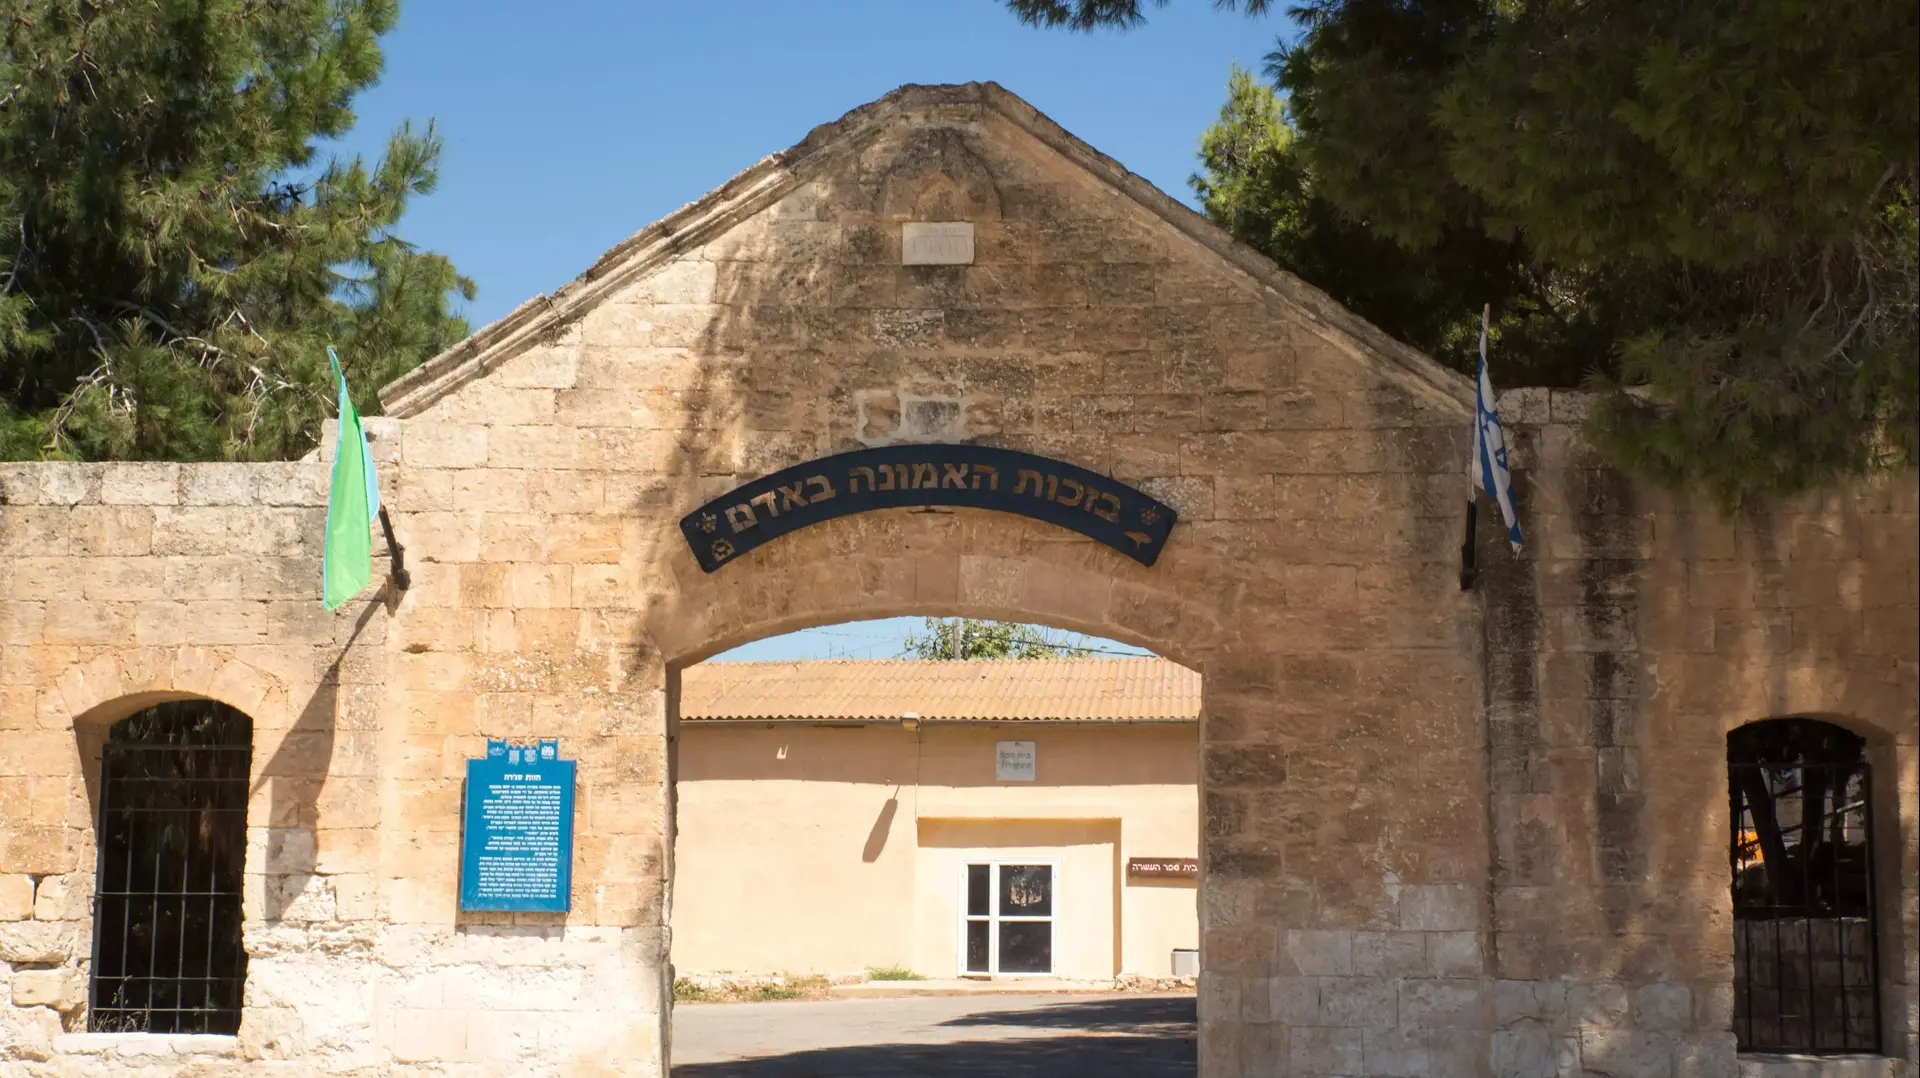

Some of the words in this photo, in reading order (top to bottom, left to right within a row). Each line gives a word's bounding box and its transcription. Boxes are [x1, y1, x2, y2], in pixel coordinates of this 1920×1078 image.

[849, 461, 999, 494] האמונה
[1014, 467, 1122, 523] בזכות
[723, 474, 837, 535] באדם
[1163, 863, 1180, 871] ספר
